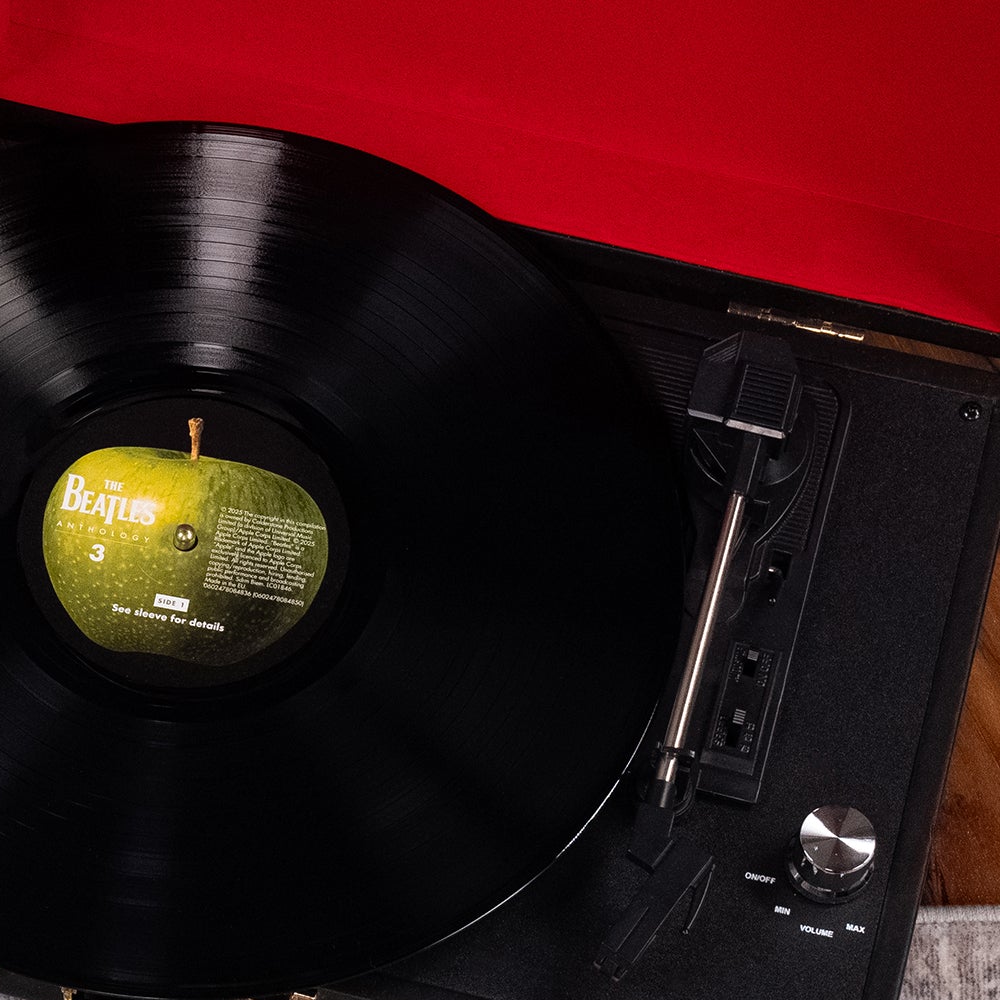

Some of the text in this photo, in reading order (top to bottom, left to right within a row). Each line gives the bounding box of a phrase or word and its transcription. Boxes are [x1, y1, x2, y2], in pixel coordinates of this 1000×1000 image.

[104, 479, 125, 492] THE
[60, 474, 157, 526] BEATLES
[56, 520, 150, 543] ANTHOLOGY
[89, 544, 105, 562] 3
[158, 597, 177, 607] SIDE
[112, 603, 225, 632] See sleeve for details
[745, 871, 776, 884] ON/OFF
[774, 906, 791, 916] MIN
[800, 924, 833, 938] VOLUME
[846, 923, 865, 933] MAX
